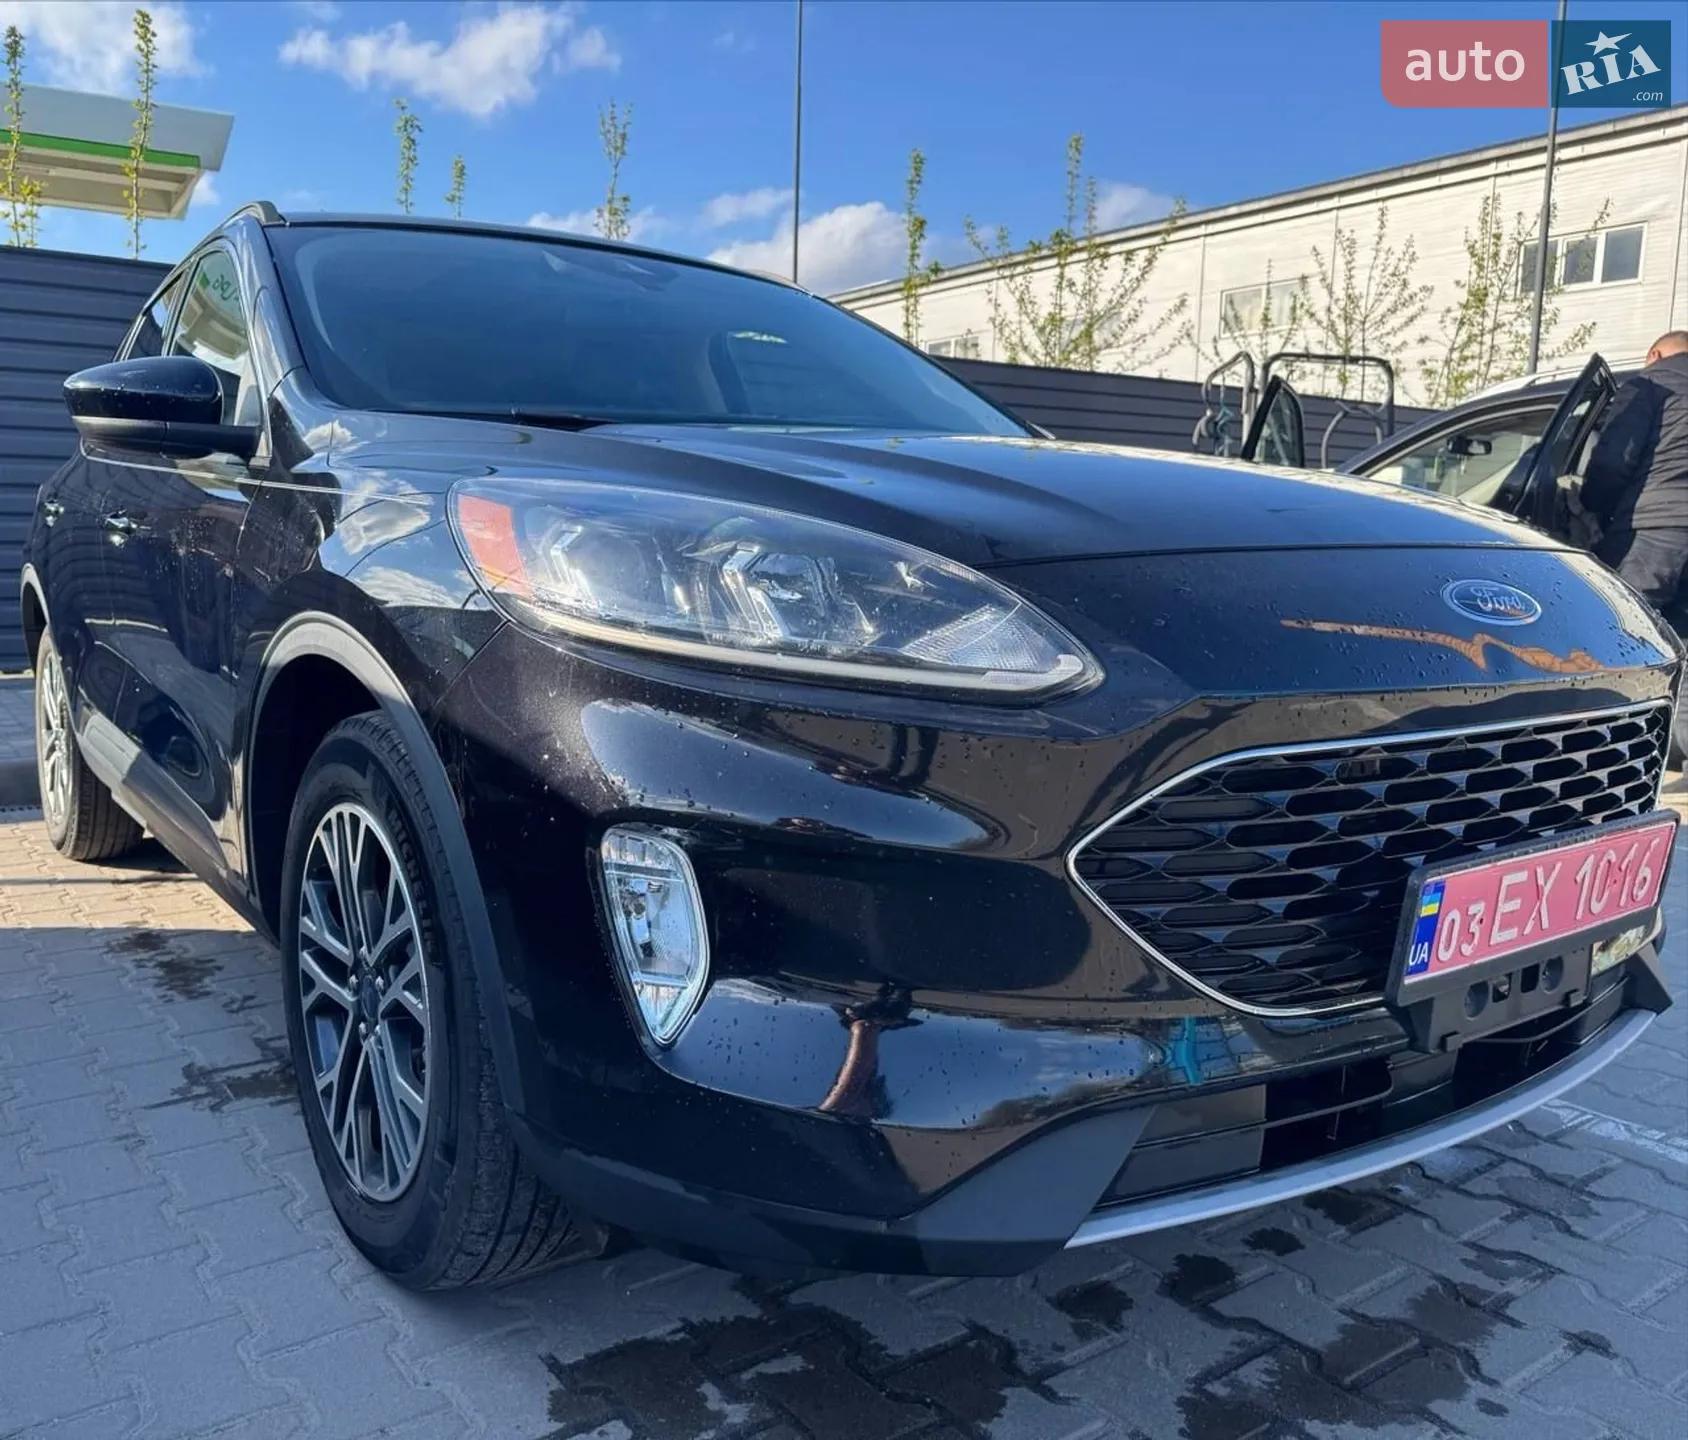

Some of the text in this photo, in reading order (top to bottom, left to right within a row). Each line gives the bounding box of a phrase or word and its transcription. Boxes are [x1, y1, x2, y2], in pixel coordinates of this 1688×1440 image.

[1464, 586, 1527, 612] Ford
[387, 807, 436, 954] MICHELIN
[1437, 836, 1661, 963] 03 EX 1016
[1408, 941, 1429, 966] UA
